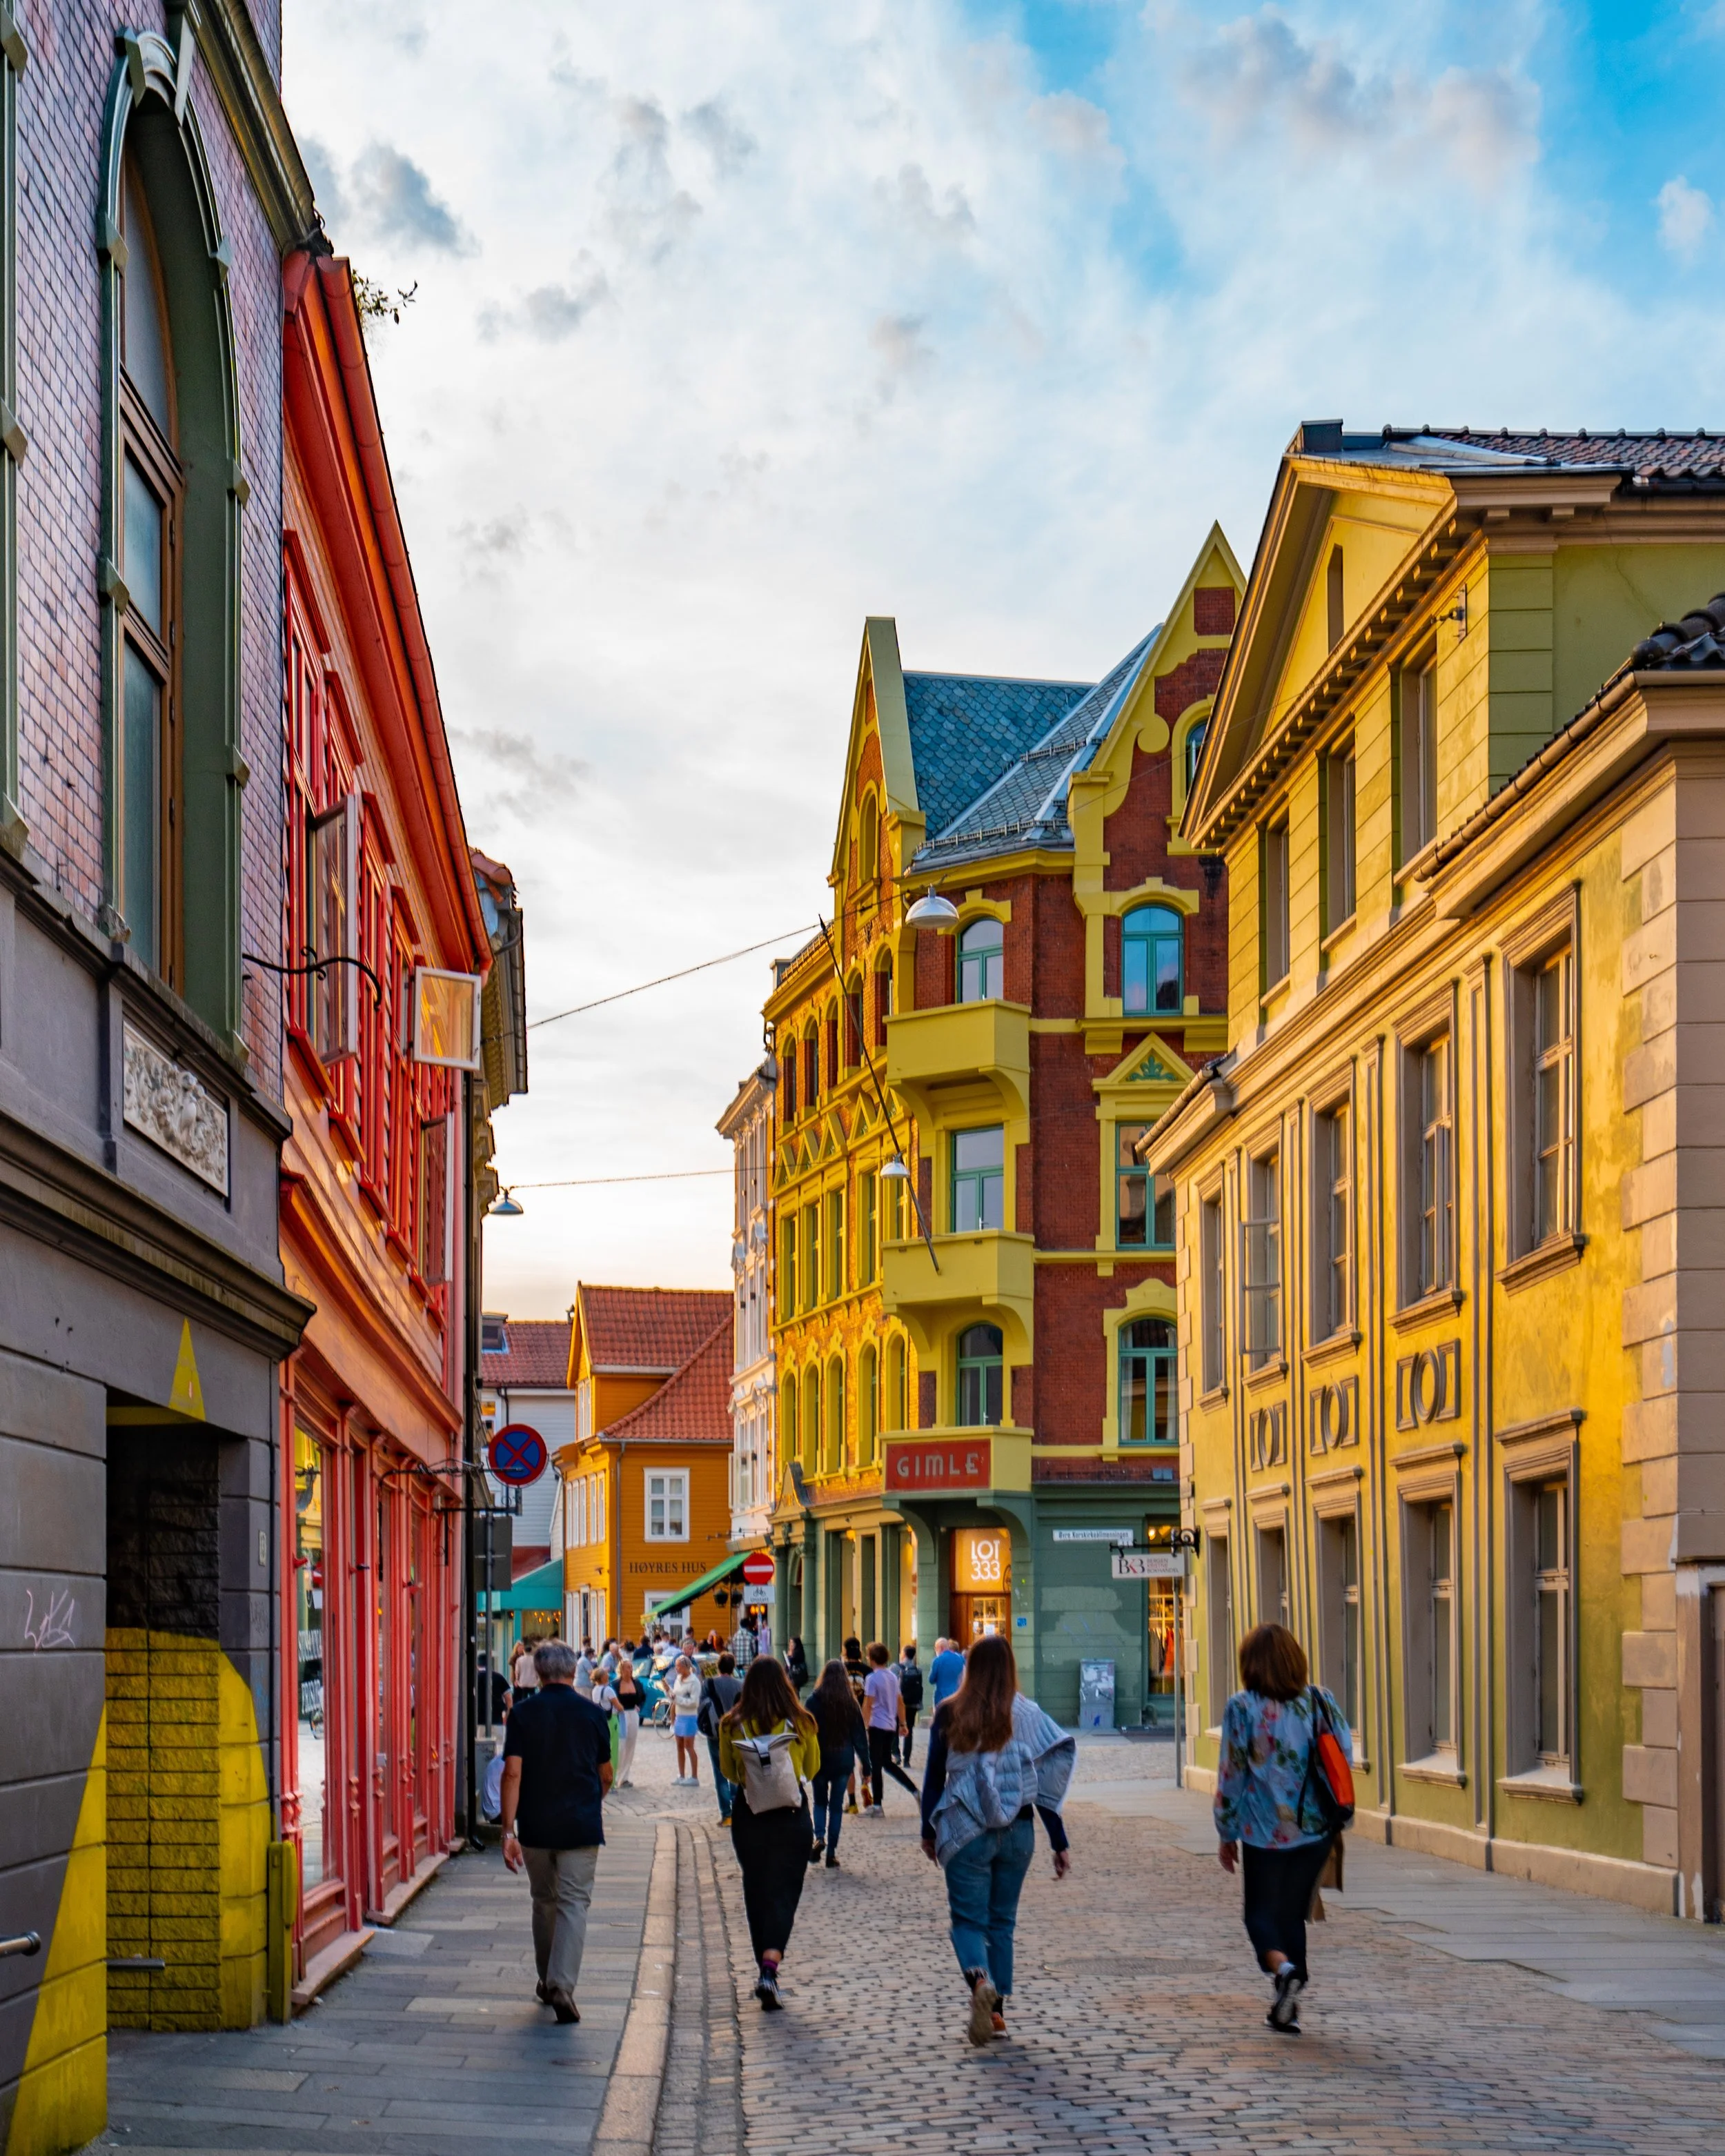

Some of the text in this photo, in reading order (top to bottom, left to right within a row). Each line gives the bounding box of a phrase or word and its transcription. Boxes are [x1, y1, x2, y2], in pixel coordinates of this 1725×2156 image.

[896, 1452, 979, 1478] GIMLE
[971, 1539, 1000, 1560] LOT
[629, 1561, 707, 1573] HØYRES HUS
[971, 1559, 1000, 1581] 333
[1118, 1559, 1145, 1574] BKB
